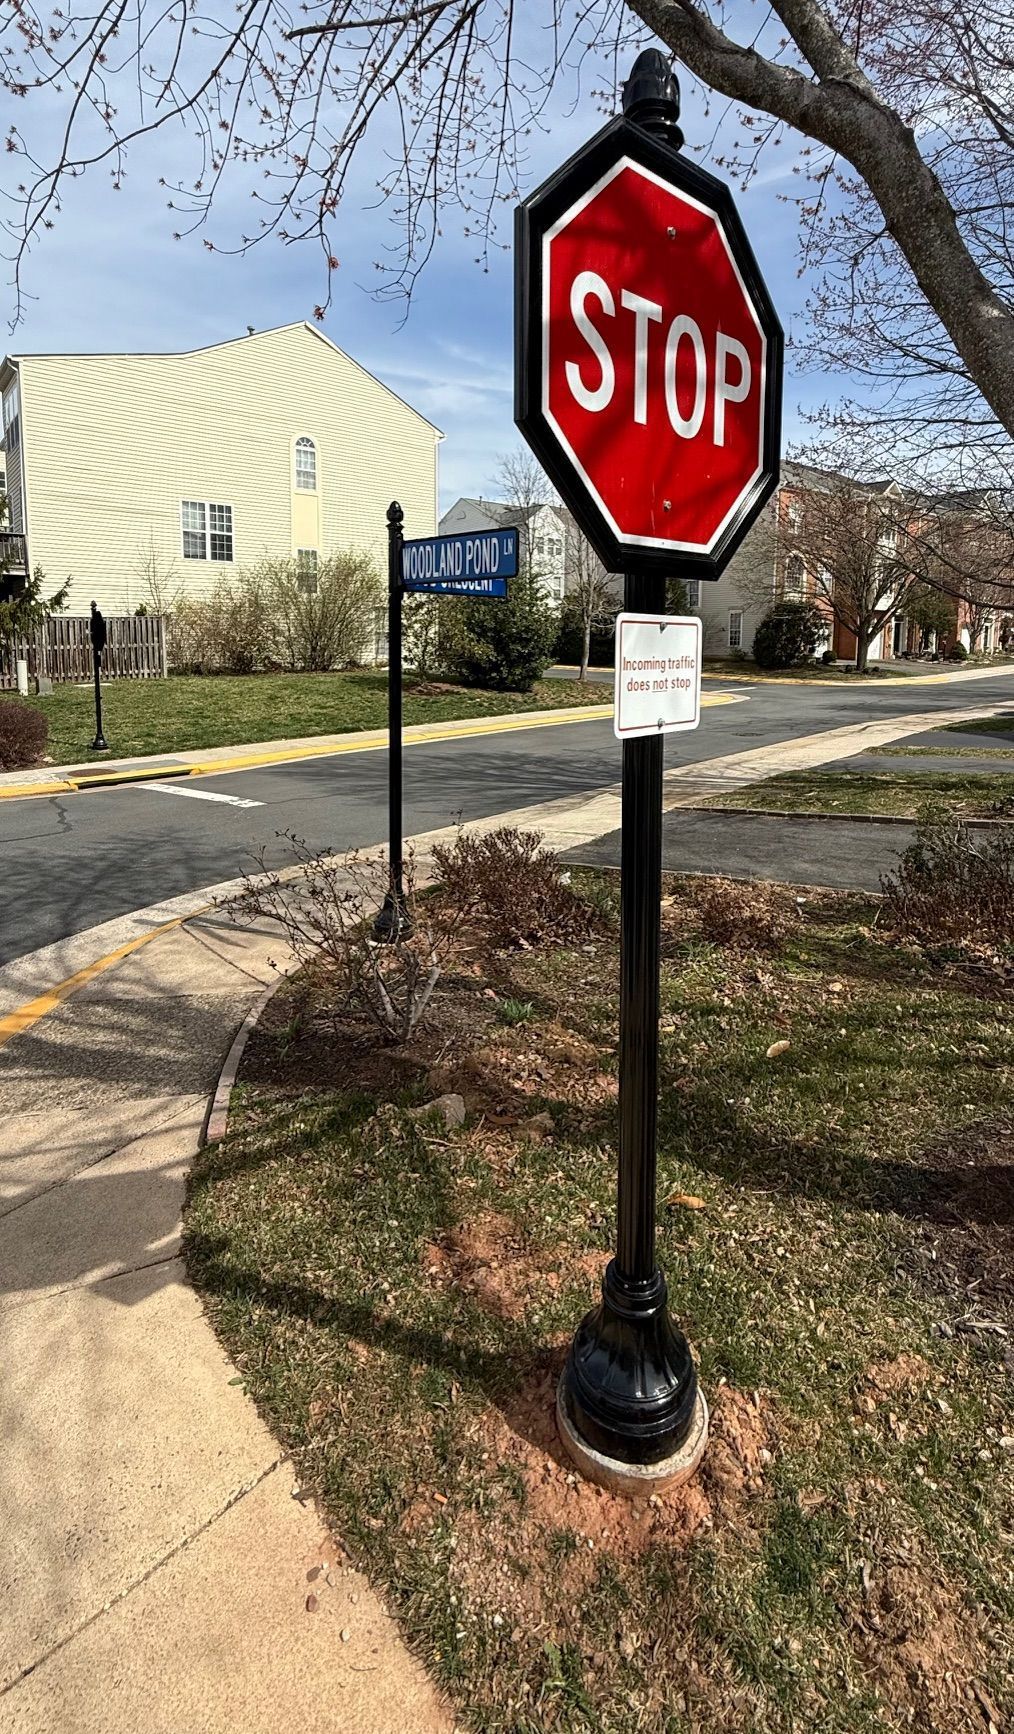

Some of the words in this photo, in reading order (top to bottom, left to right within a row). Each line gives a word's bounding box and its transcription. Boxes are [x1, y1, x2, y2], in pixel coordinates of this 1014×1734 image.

[565, 271, 752, 447] STOP
[402, 541, 463, 579] WOODLAND
[466, 537, 499, 574] POND
[503, 538, 513, 555] LN
[623, 656, 666, 673] Incoming
[668, 655, 695, 670] traffic
[627, 677, 650, 692] does
[653, 677, 668, 691] not
[671, 676, 691, 691] stop
